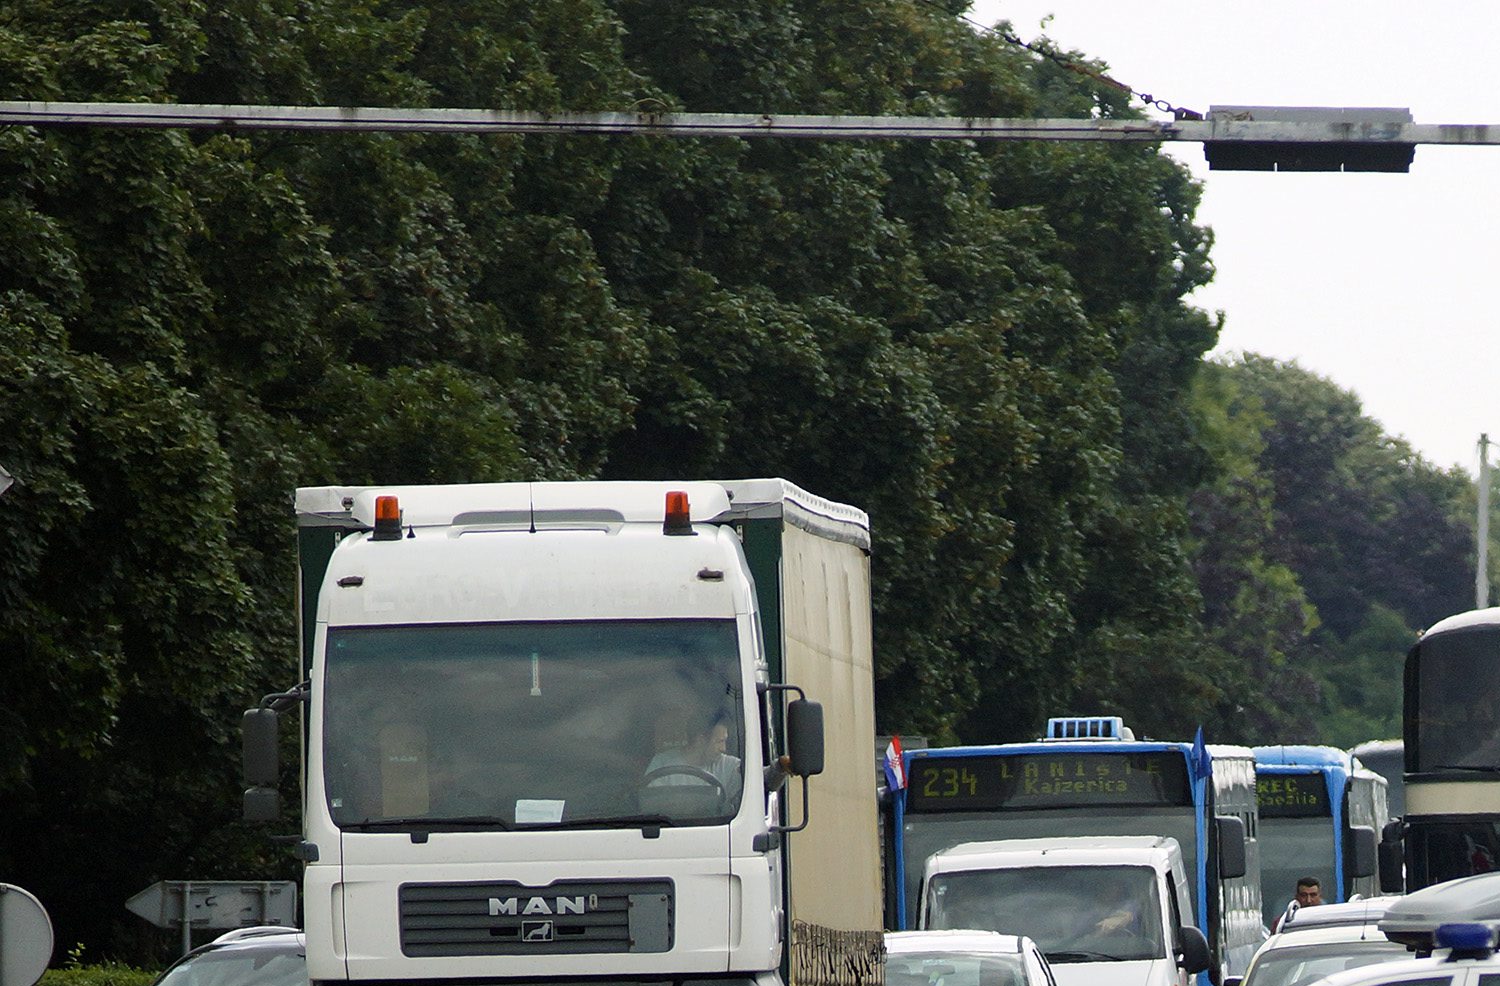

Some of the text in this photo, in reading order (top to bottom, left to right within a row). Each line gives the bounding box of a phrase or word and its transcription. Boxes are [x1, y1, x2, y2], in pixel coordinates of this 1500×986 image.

[923, 766, 977, 797] 234
[1023, 777, 1128, 796] Kajzerica
[488, 896, 585, 916] MAN
